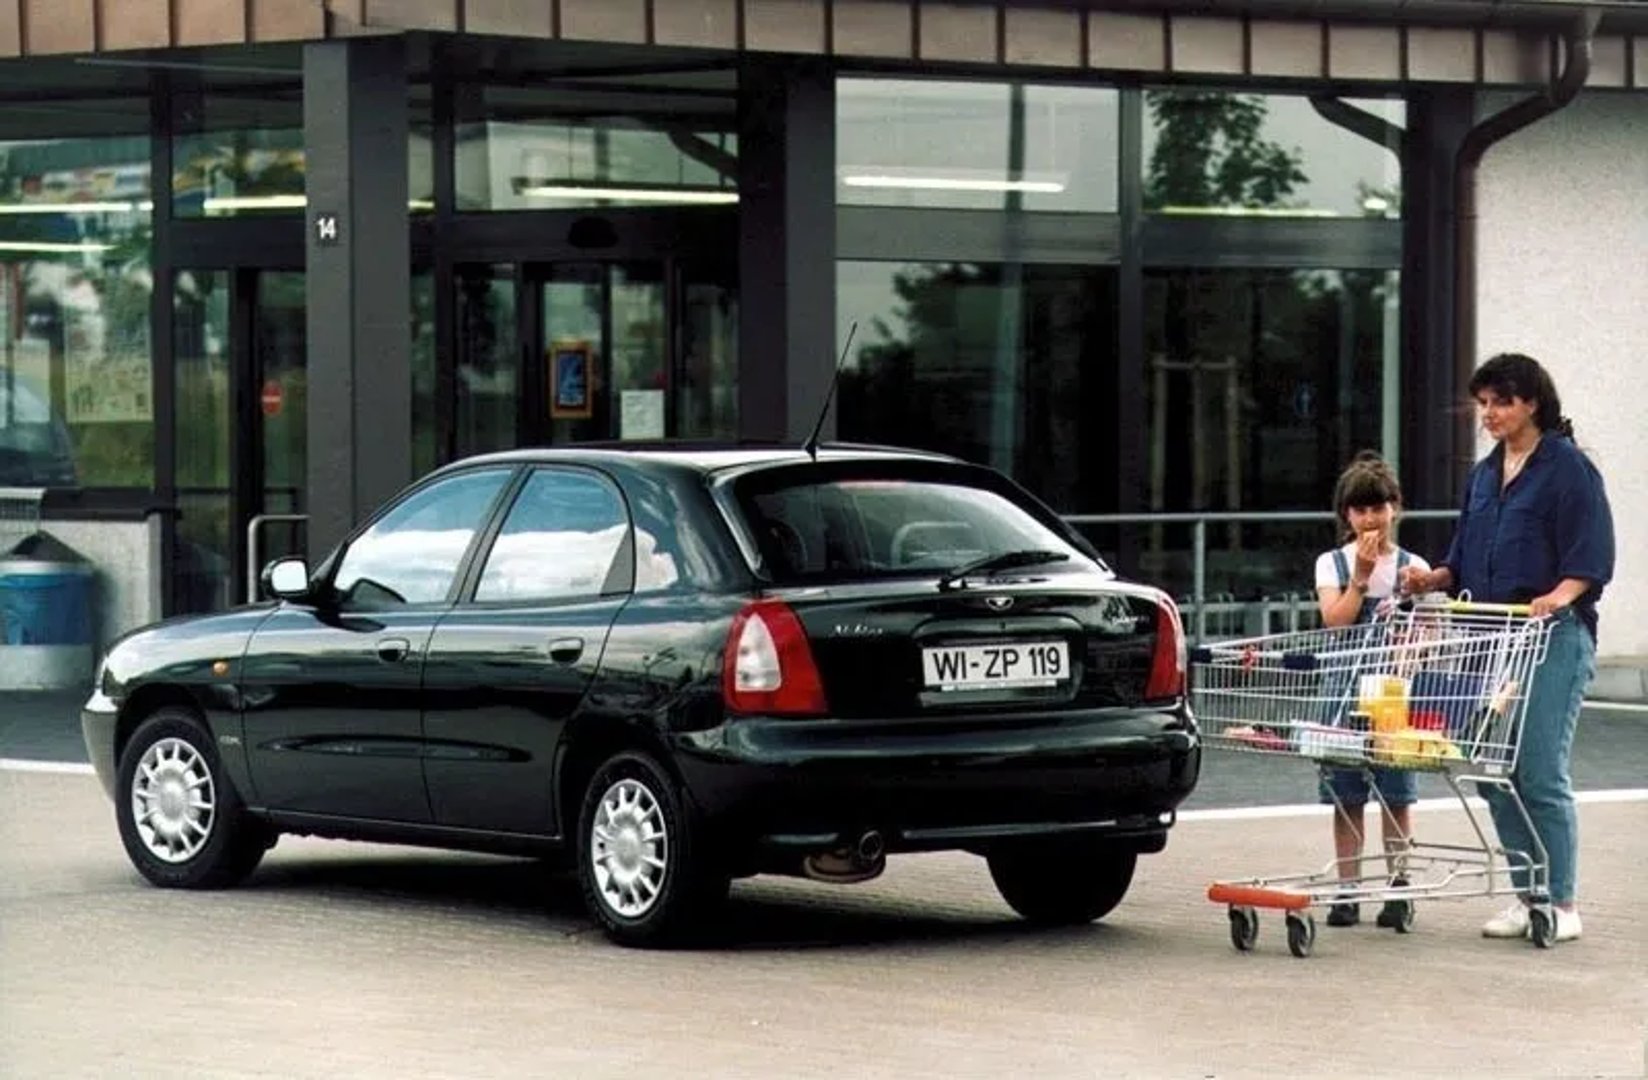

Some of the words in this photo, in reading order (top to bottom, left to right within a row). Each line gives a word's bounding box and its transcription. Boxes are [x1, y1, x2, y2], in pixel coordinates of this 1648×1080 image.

[317, 217, 336, 239] 14
[933, 648, 1020, 681] WI-ZP
[1028, 646, 1061, 676] 119
